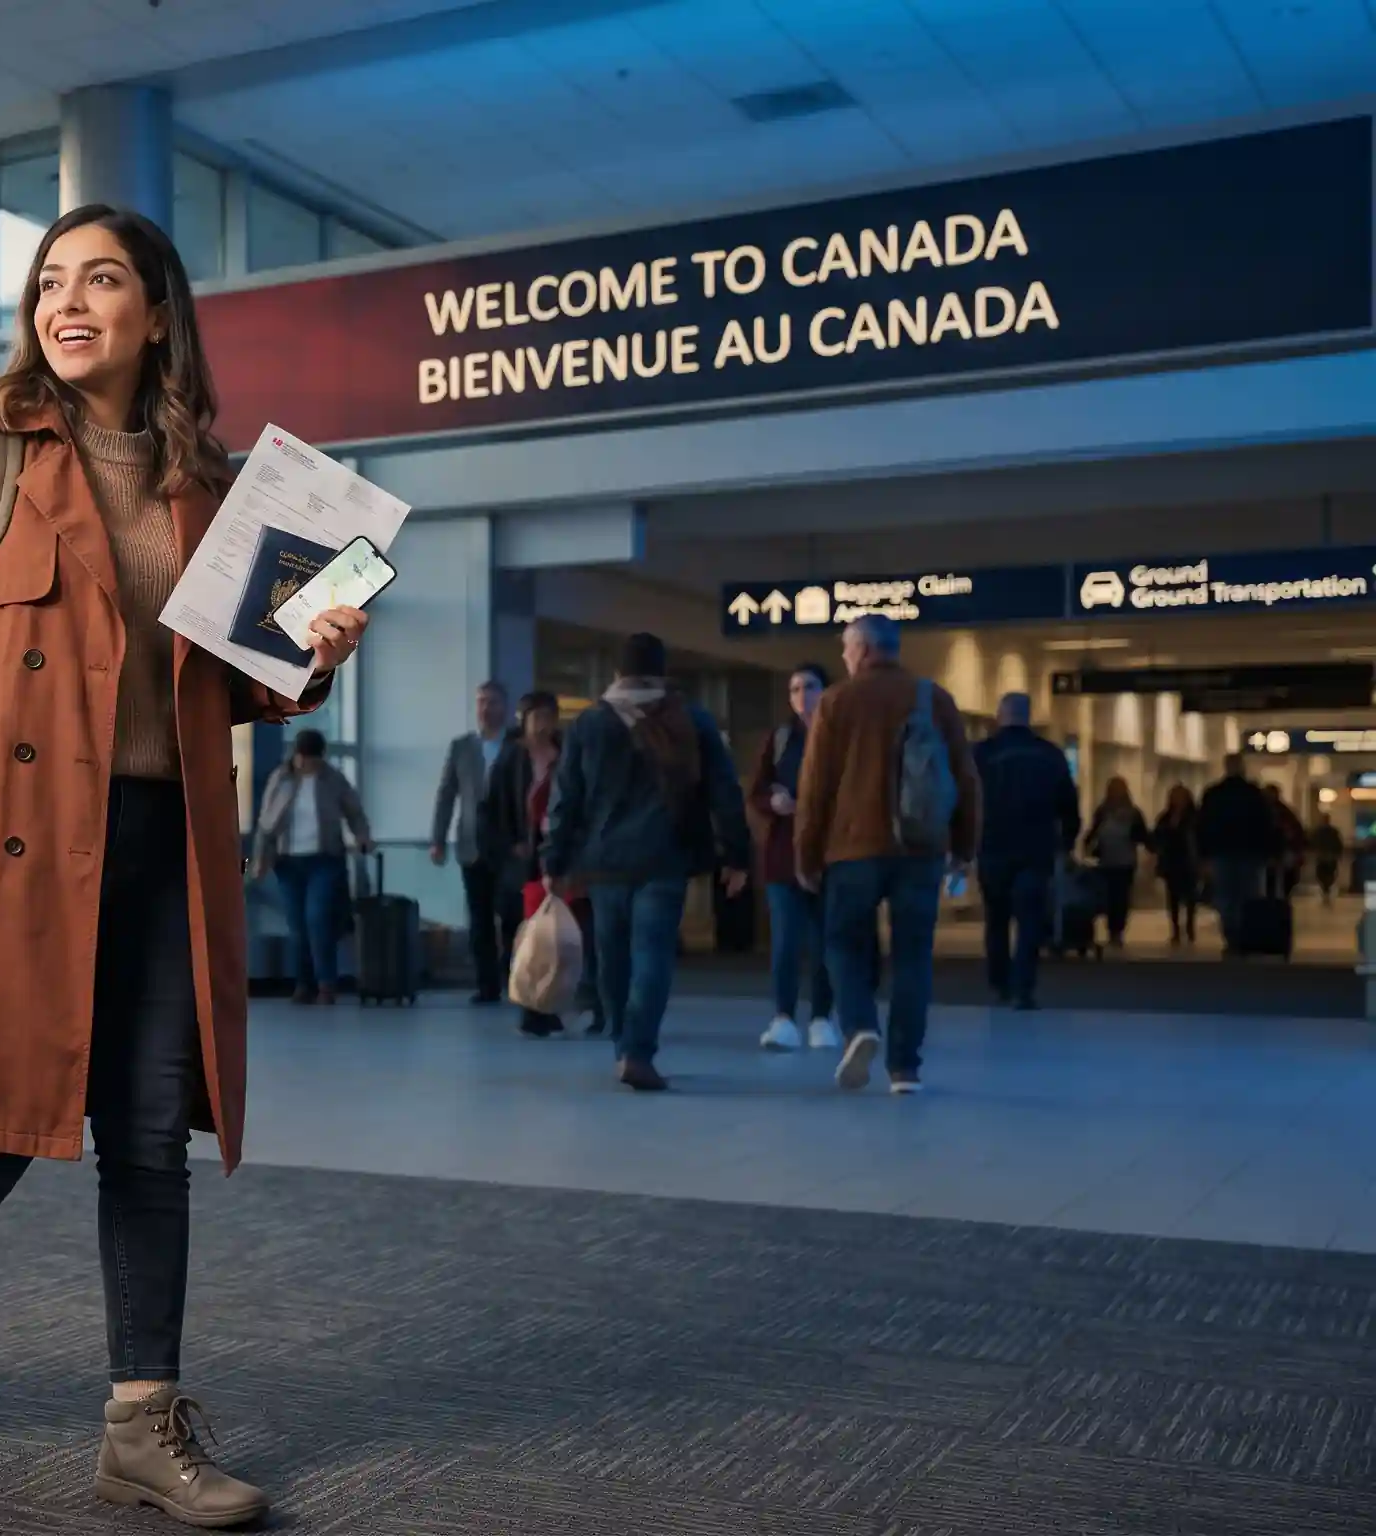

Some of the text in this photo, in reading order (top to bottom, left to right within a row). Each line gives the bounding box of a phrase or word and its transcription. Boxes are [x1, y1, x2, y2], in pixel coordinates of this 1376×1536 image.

[424, 209, 1028, 336] WELCOME TO CANADA
[418, 281, 1059, 404] BIENVENUE AU CANADA
[1129, 558, 1209, 587] Ground
[1130, 574, 1368, 609] Ground Transportation
